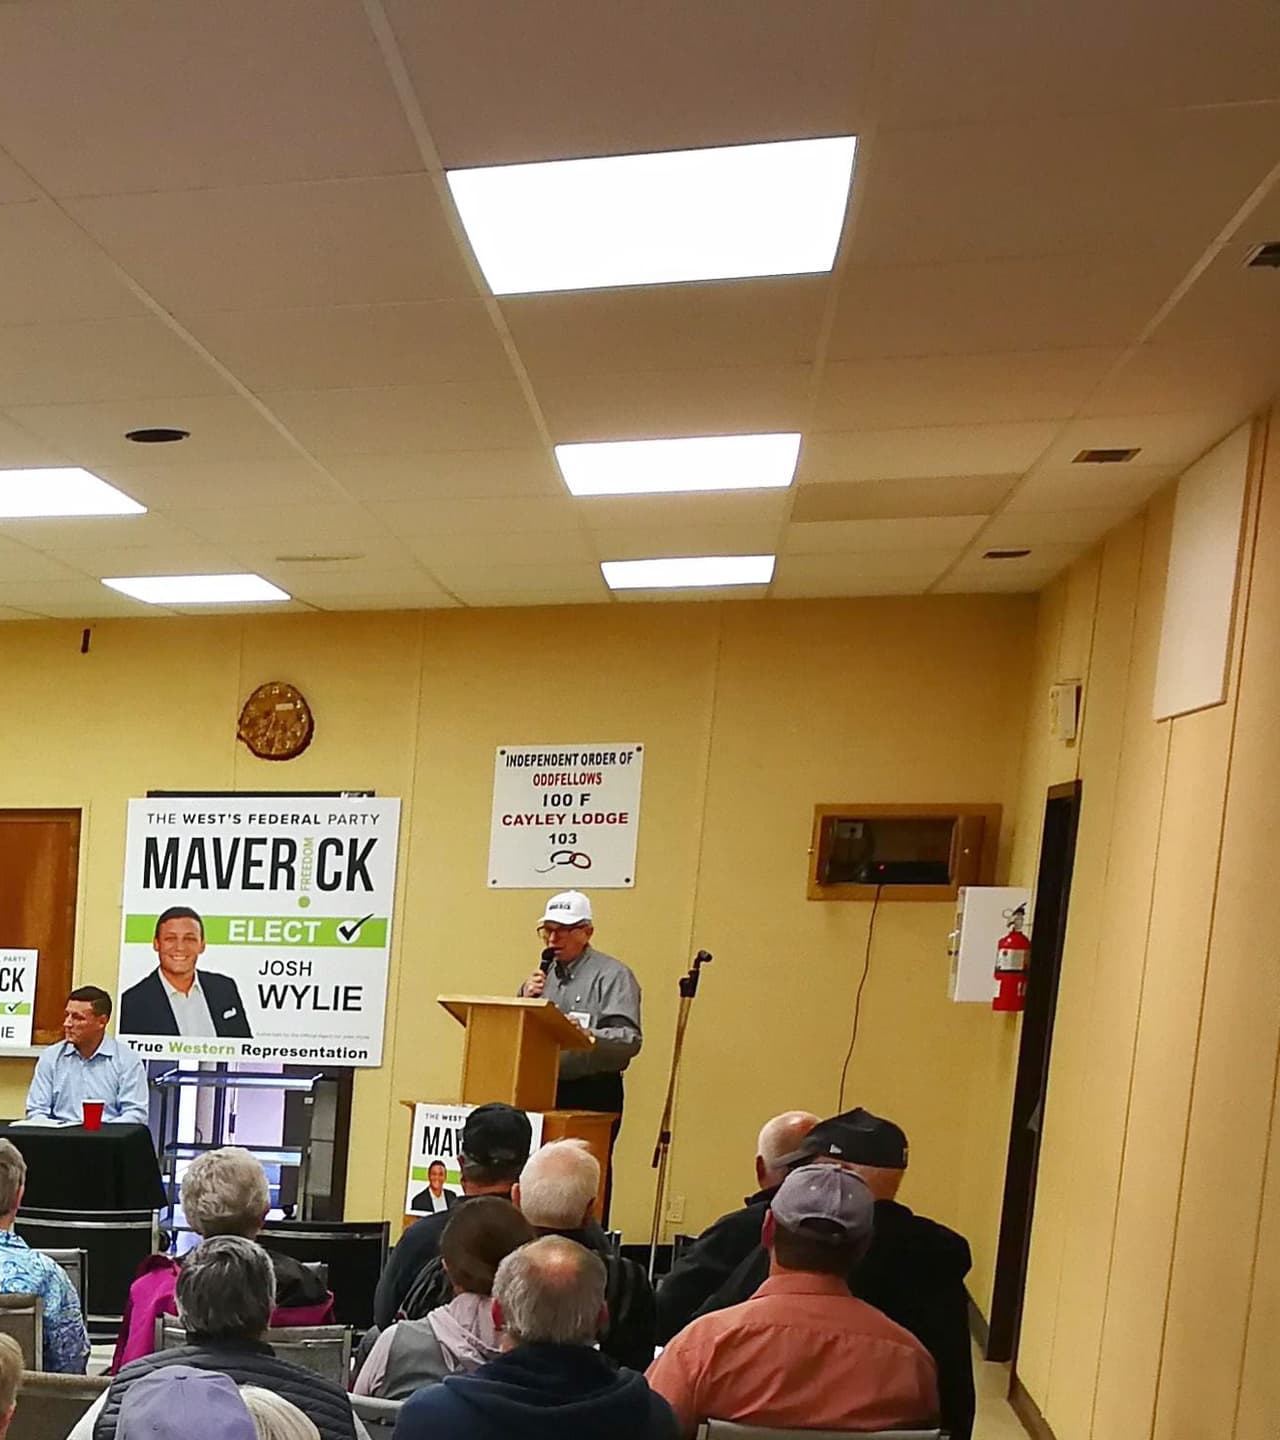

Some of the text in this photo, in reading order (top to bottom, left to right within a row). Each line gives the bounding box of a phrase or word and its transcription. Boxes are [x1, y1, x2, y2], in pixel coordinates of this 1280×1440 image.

[506, 751, 633, 767] INDEPENDENT ORDER OF
[533, 772, 602, 786] ODDFELLOWS
[580, 793, 591, 806] F
[147, 813, 380, 825] THE WEST'S FEDERAL PARTY
[502, 812, 629, 826] CAYLEY LODGE
[549, 833, 578, 845] 103
[300, 836, 314, 891] FREEDOM
[228, 919, 321, 943] ELECT
[258, 960, 313, 977] JOSH
[258, 984, 363, 1012] WYLIE
[127, 1040, 369, 1060] True Western Representation
